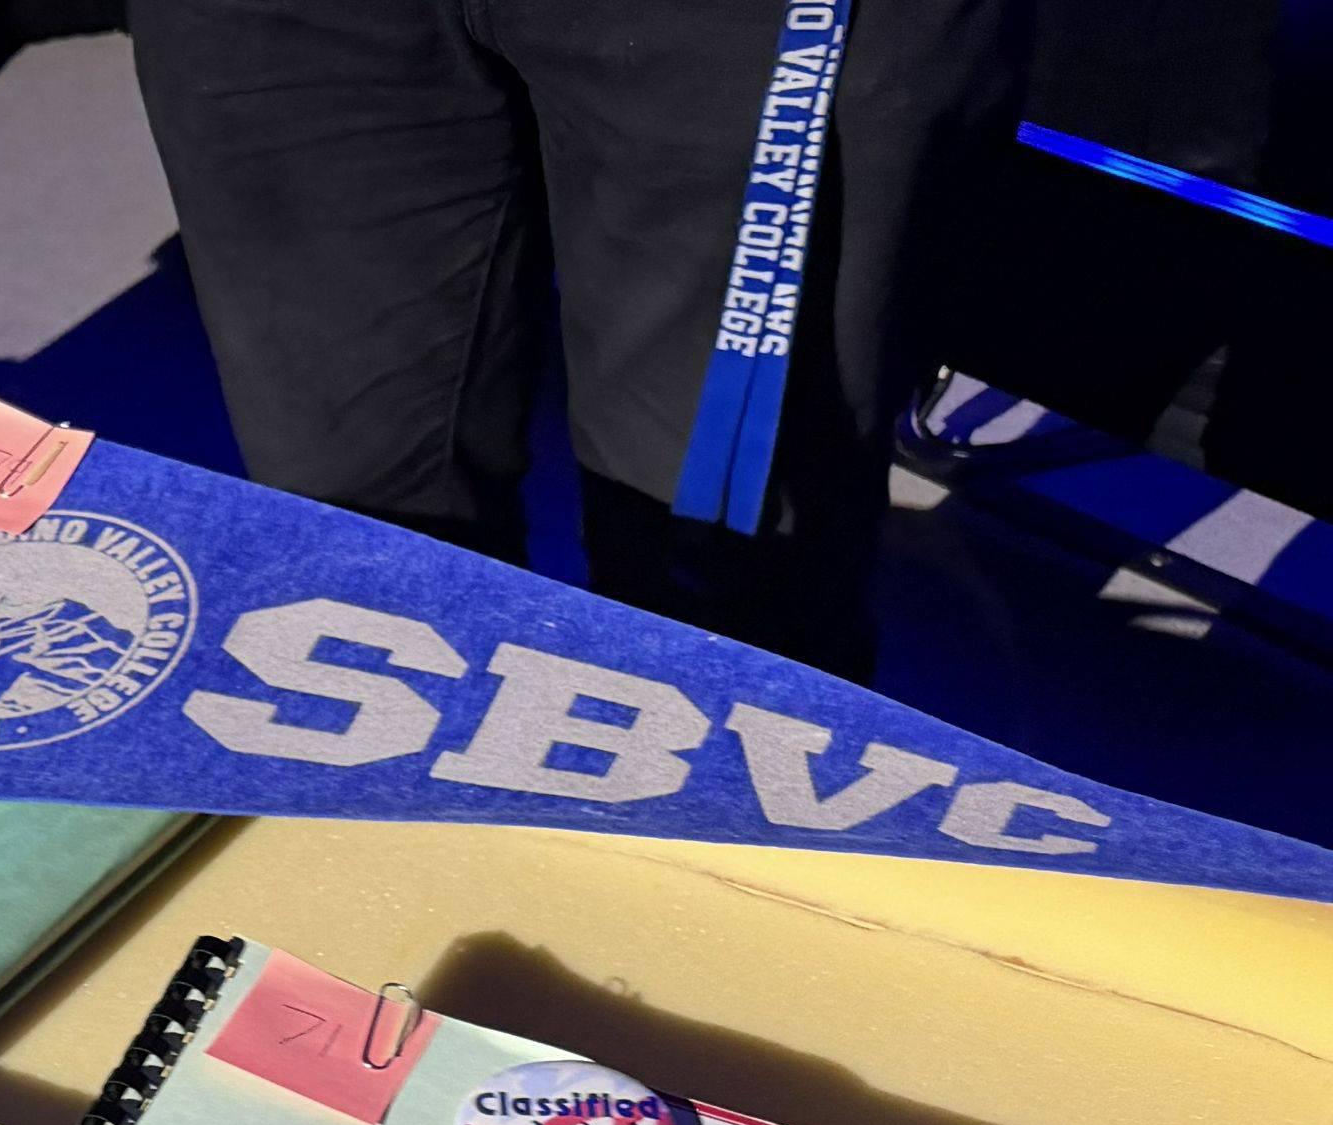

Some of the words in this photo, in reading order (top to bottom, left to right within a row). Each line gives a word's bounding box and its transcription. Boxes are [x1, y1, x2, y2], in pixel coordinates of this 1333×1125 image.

[750, 43, 828, 193] VALLEY
[715, 202, 788, 358] COLLEGE
[93, 526, 187, 604] VALLEY
[67, 611, 185, 723] COLLEGE
[181, 597, 1112, 856] SBVC
[279, 1003, 344, 1058] 71
[475, 1090, 660, 1120] Classified
